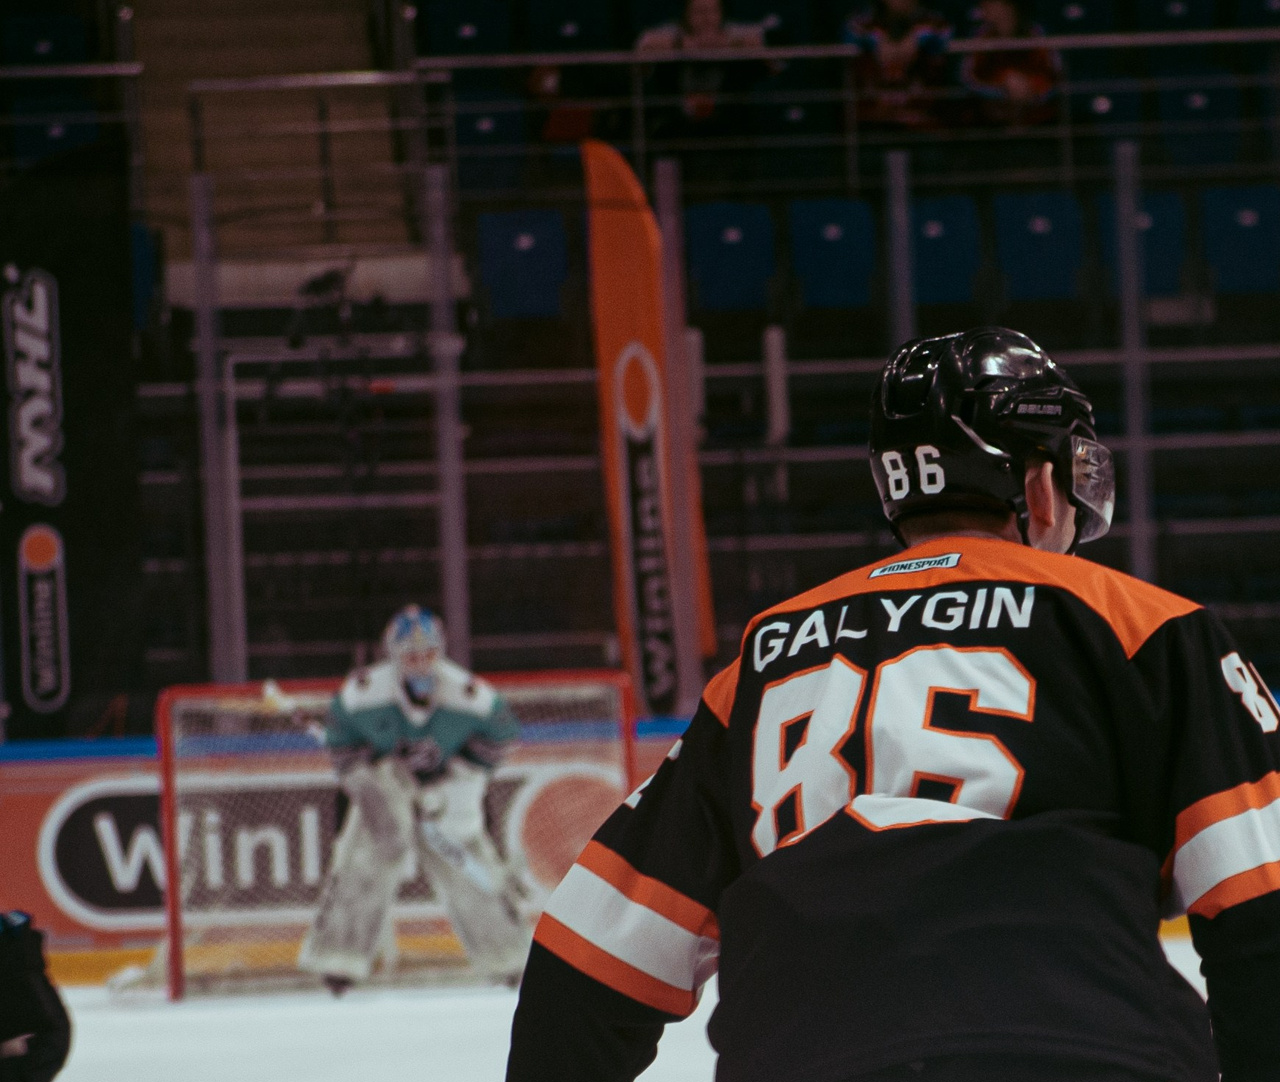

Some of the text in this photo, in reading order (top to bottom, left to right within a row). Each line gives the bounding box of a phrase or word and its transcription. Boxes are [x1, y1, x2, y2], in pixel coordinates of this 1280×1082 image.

[882, 443, 946, 501] 86
[634, 455, 676, 698] Winline
[753, 586, 1036, 673] GALYGIN
[750, 643, 1038, 860] 86
